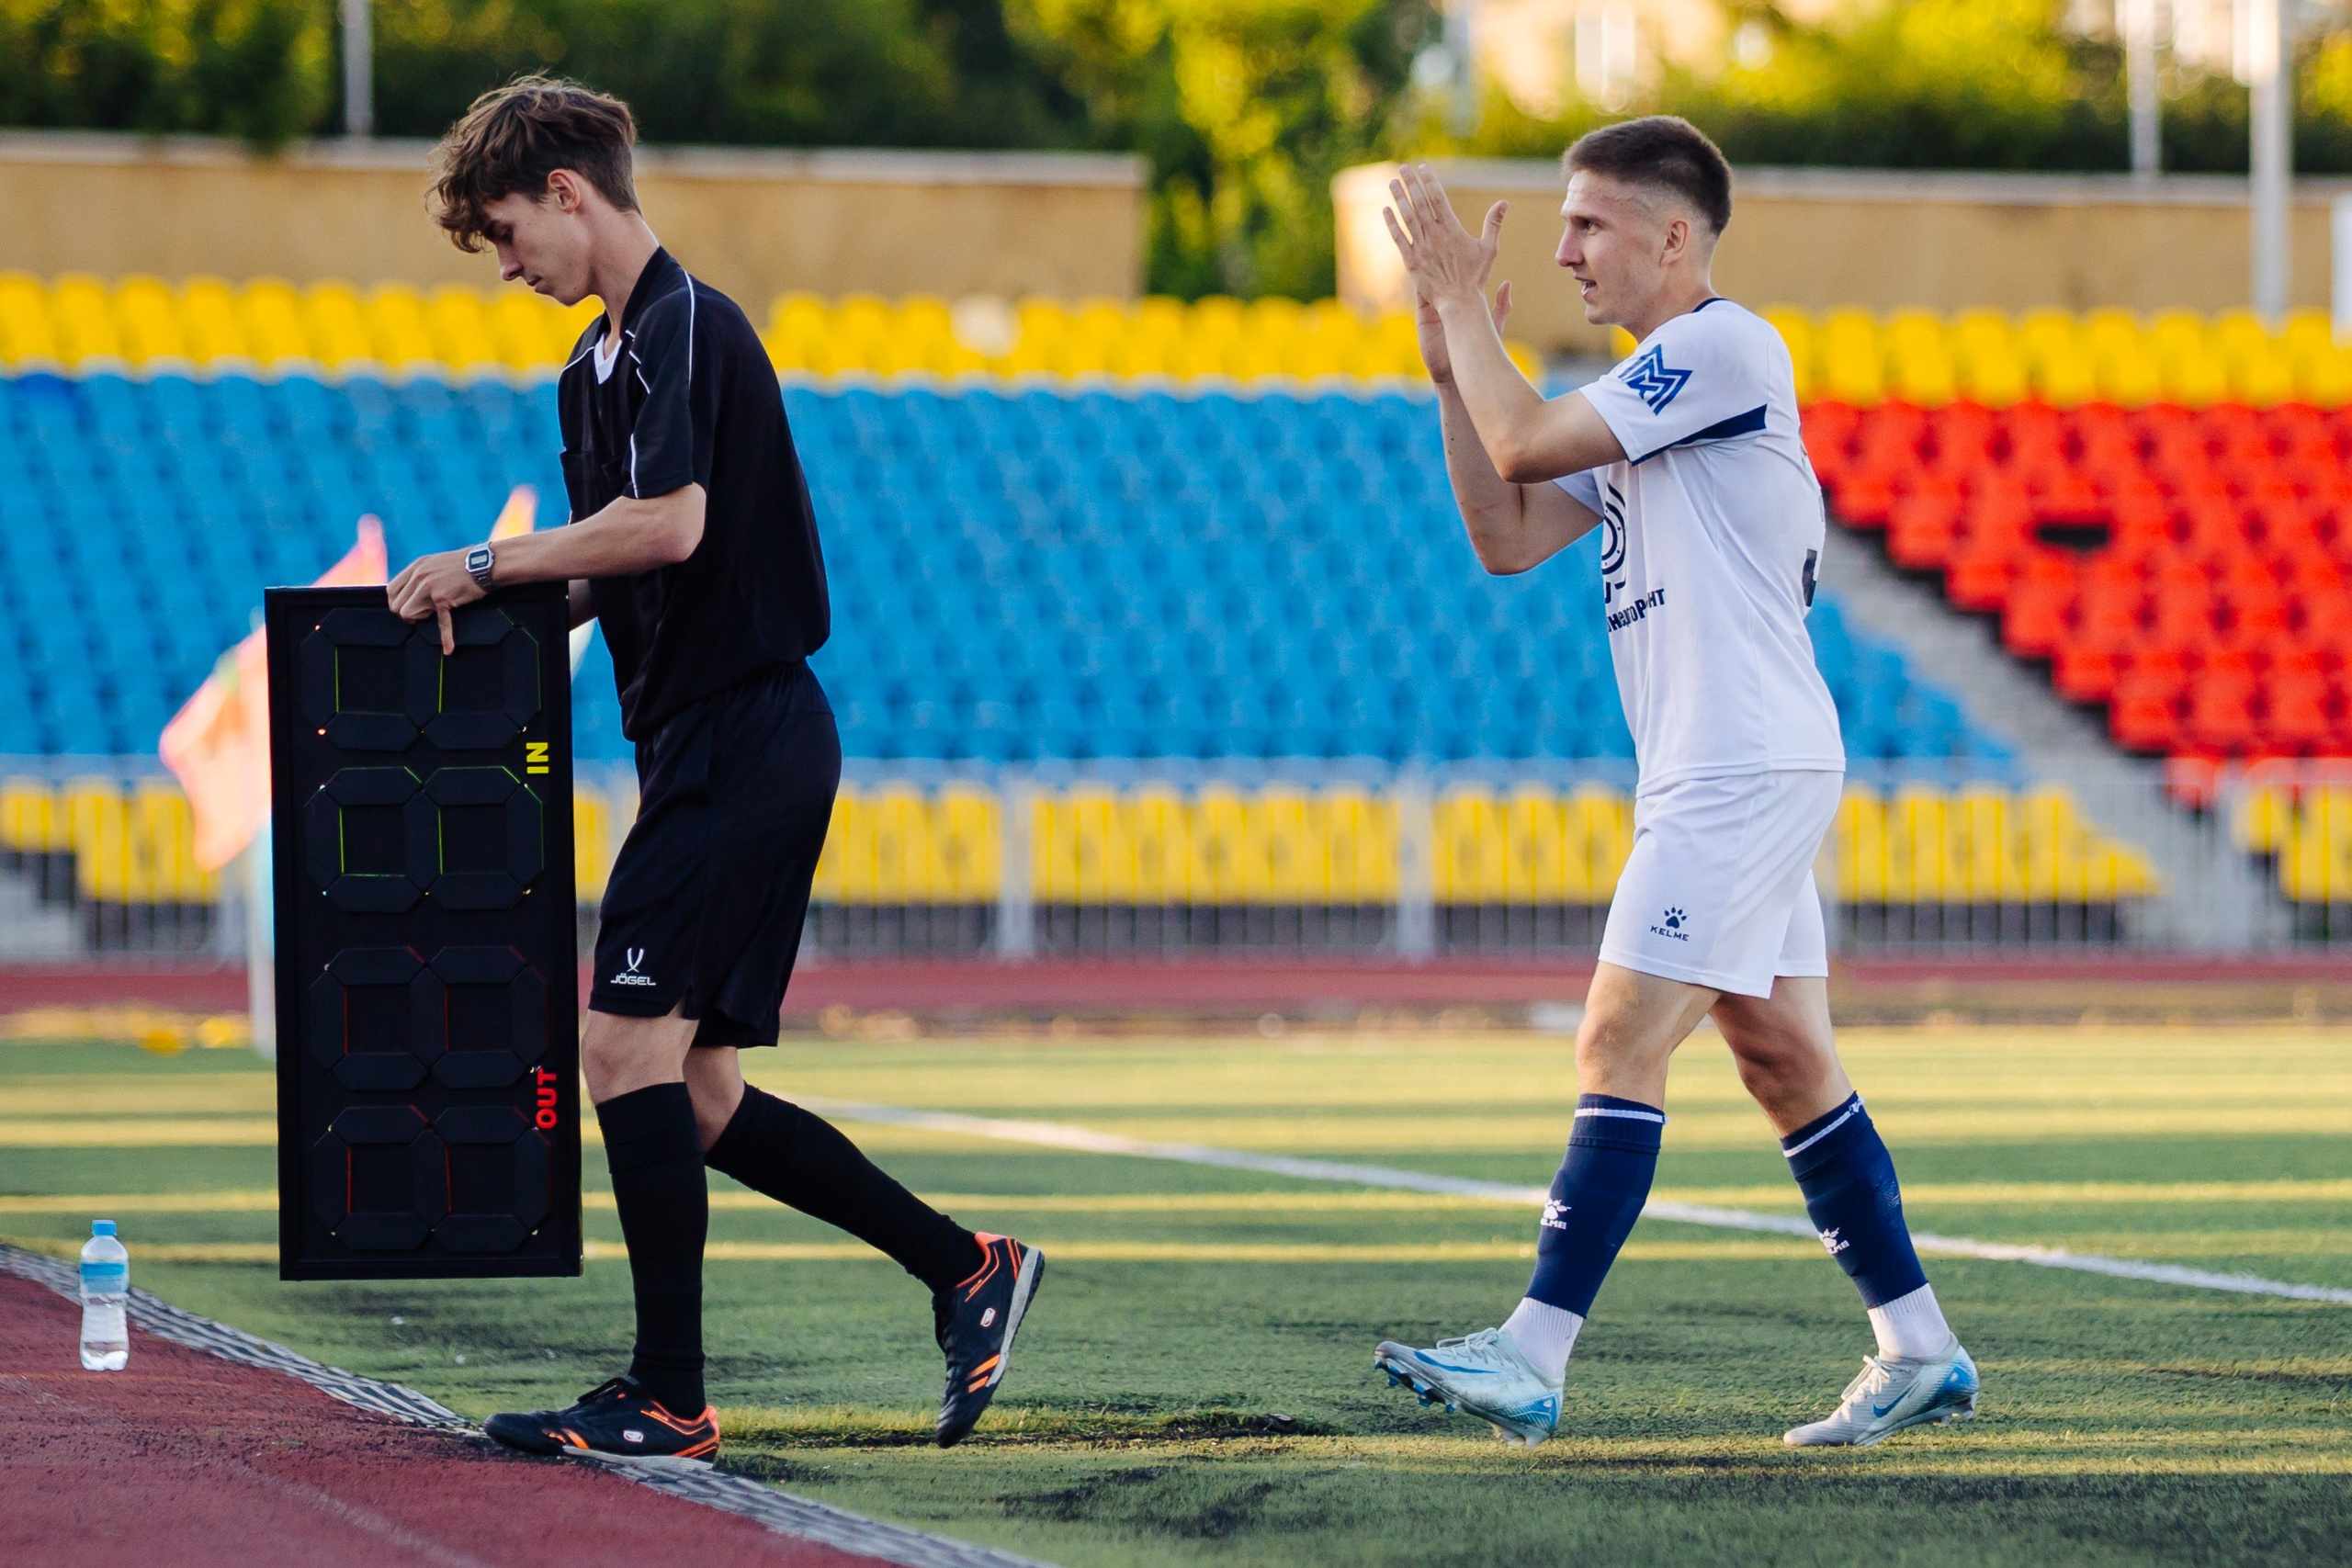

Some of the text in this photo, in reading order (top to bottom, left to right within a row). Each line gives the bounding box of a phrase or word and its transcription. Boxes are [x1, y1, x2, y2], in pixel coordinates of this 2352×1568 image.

[526, 742, 549, 774] IN
[1650, 924, 1690, 942] KELME
[610, 973, 656, 986] JÖGEL
[536, 1066, 558, 1129] OUT
